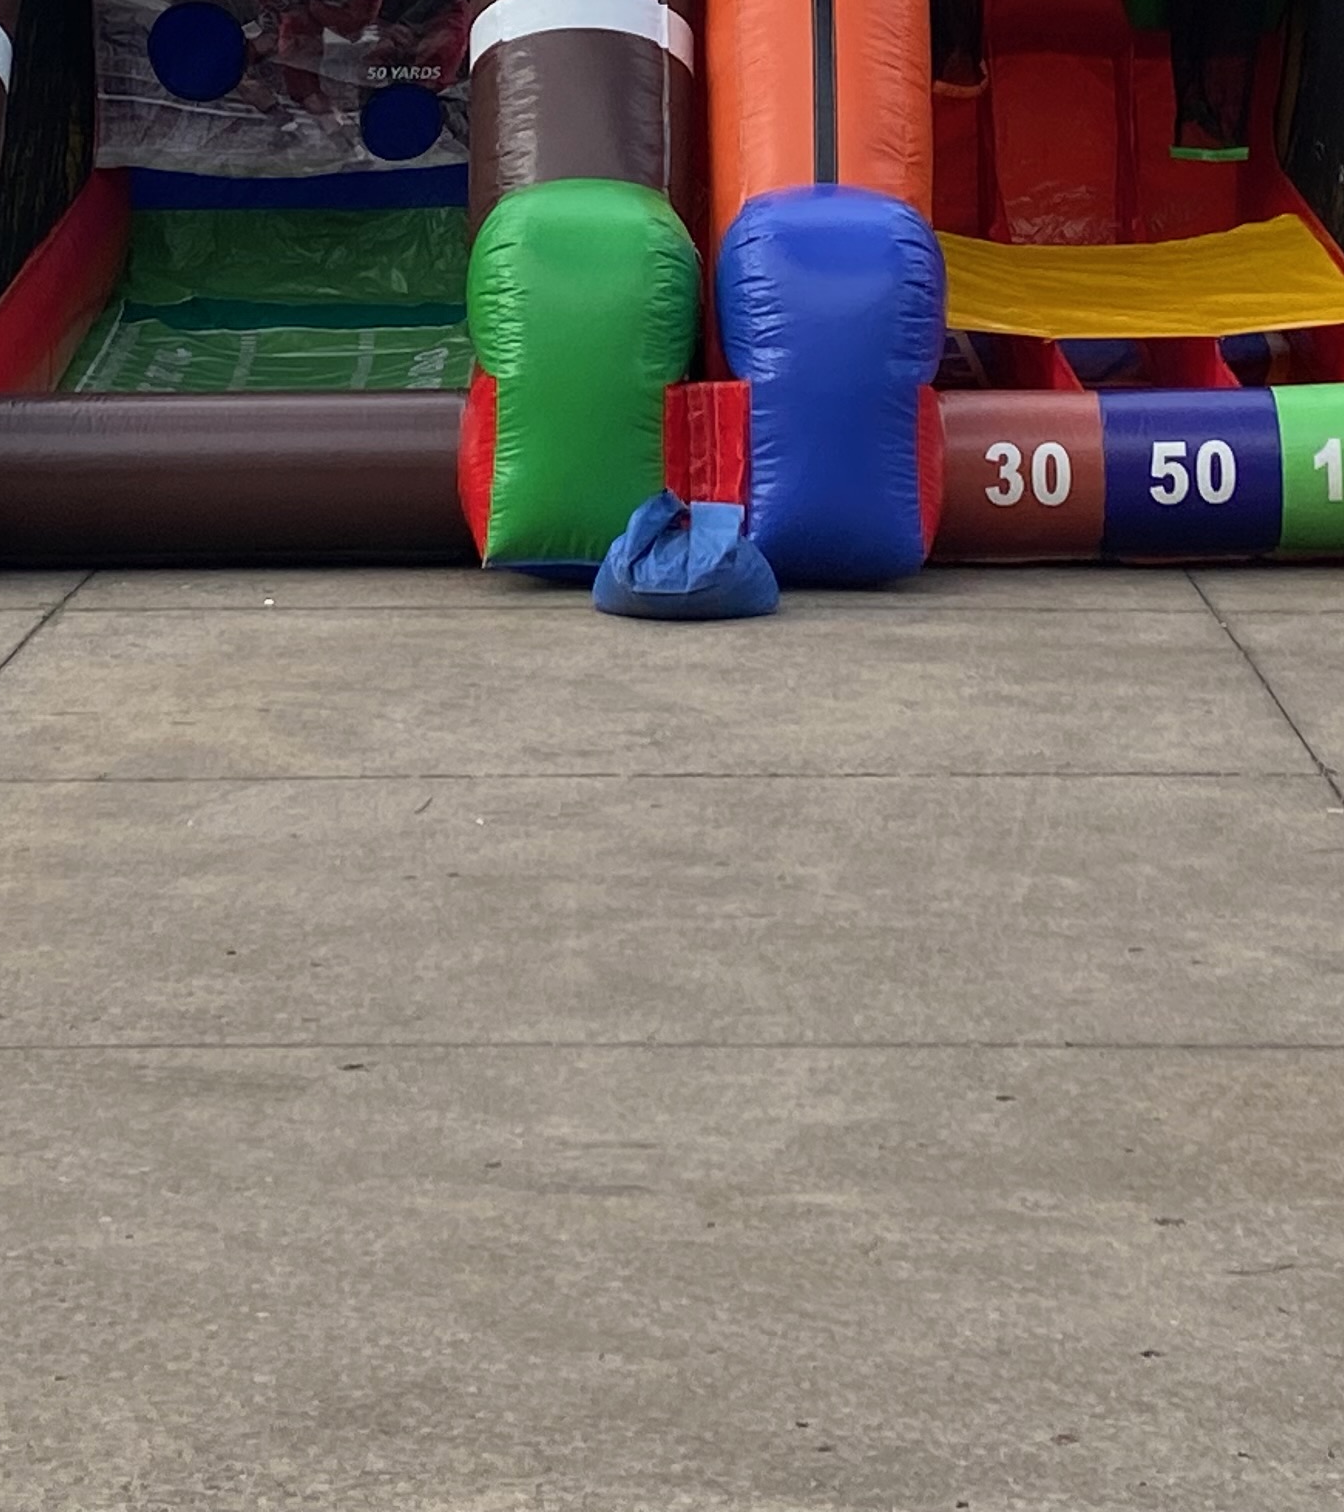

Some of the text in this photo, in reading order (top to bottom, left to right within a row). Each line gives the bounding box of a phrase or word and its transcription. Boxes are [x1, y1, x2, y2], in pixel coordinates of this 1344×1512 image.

[367, 65, 442, 80] 50 YARDS
[984, 441, 1072, 506] 30
[1148, 439, 1236, 505] 50
